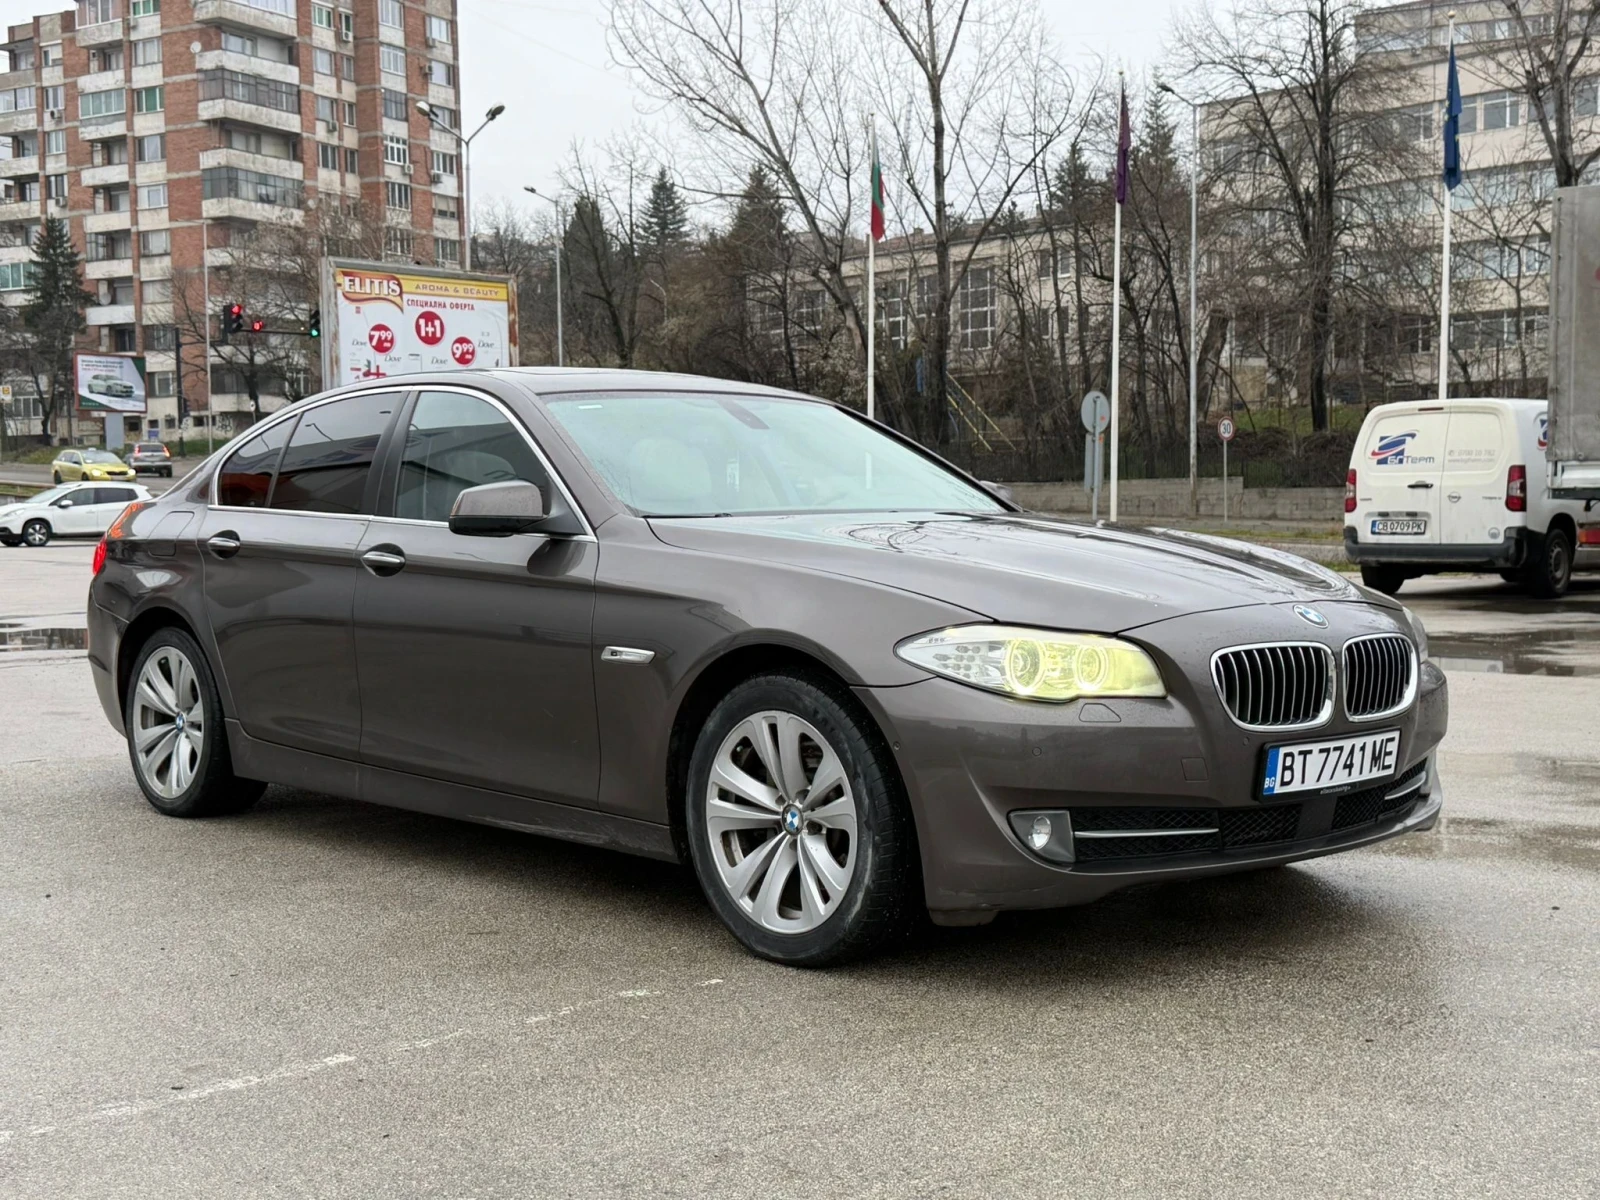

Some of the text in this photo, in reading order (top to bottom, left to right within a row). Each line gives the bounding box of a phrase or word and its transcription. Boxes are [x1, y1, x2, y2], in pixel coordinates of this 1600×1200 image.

[344, 276, 401, 297] ELITIS
[415, 283, 450, 293] AROMA
[463, 287, 499, 296] BEAUTY
[406, 298, 475, 311] СПЕЦИАЛНА ОФЕРТА
[418, 318, 441, 338] 1+1
[478, 340, 494, 348] Dove
[1222, 422, 1231, 434] 30
[1264, 776, 1276, 788] BG
